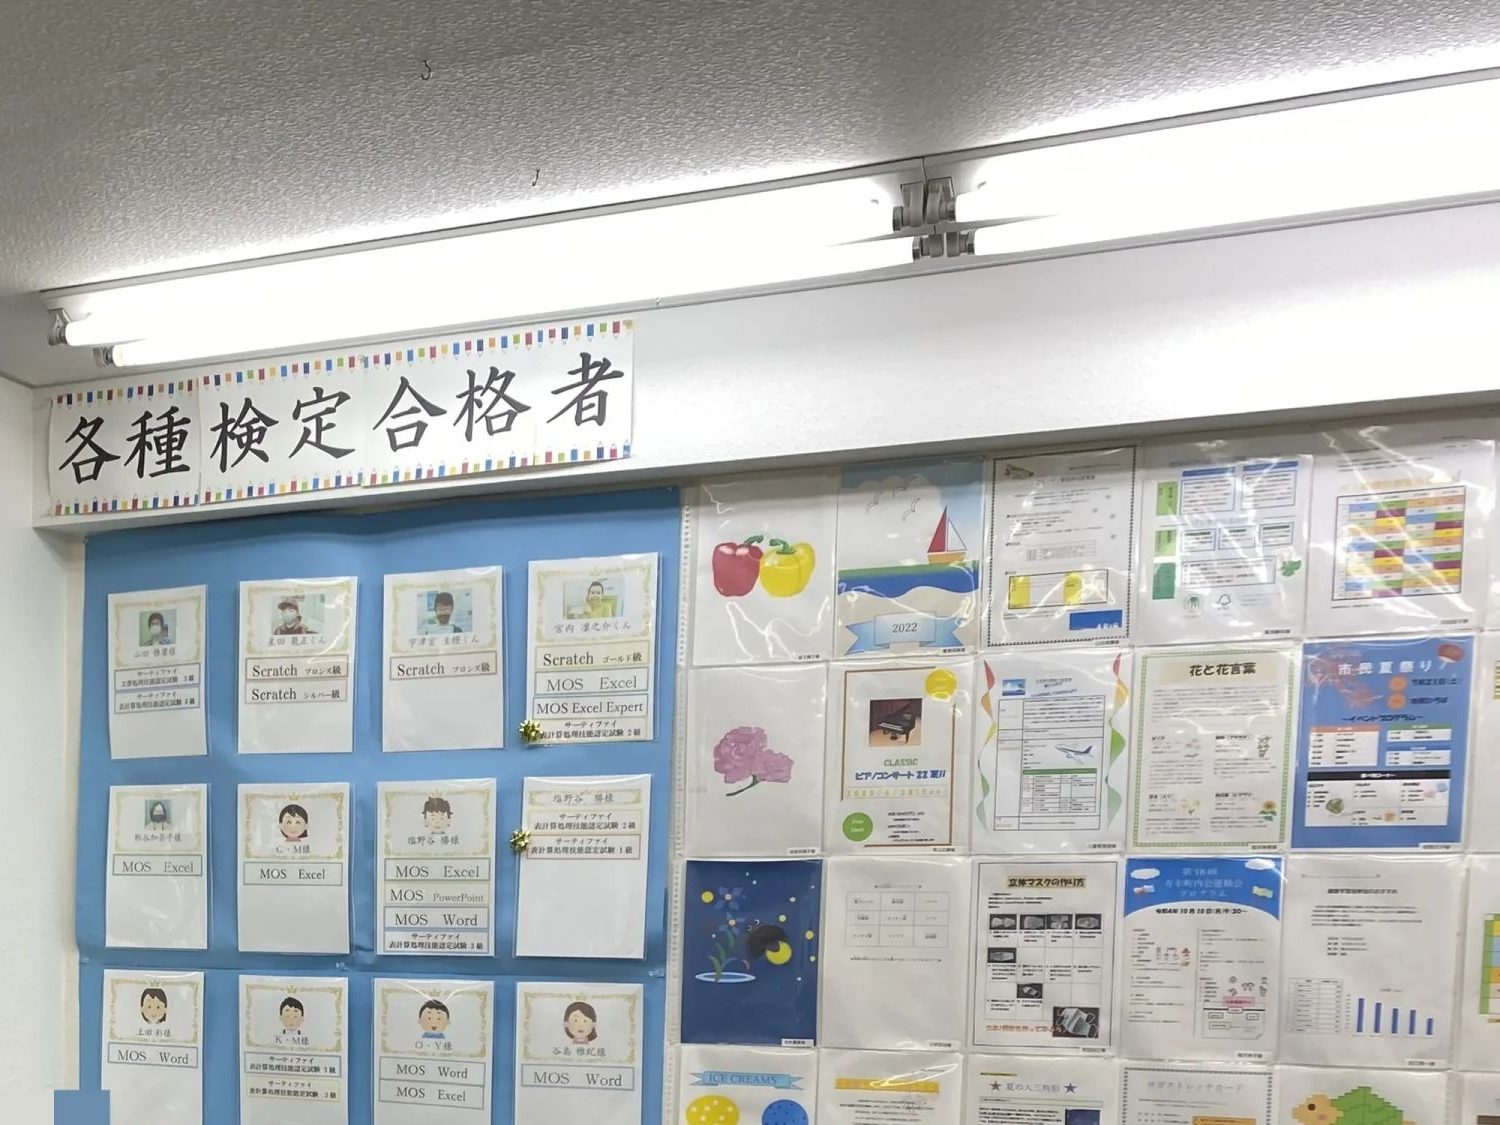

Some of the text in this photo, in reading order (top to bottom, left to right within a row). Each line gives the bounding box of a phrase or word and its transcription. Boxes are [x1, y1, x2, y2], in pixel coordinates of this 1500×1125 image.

[59, 352, 625, 486] 各種検定合格者
[892, 622, 918, 633] 2022
[543, 652, 642, 667] Scratch ゴールド級
[252, 664, 341, 677] Scratch ブロンズ級
[397, 662, 490, 677] Scratch ブロンズ級
[1190, 662, 1256, 677] 花と花言葉
[1338, 660, 1432, 676] 市民夏祭り
[547, 675, 637, 692] MOS Excel
[251, 688, 340, 701] Scratch シルバー級
[537, 701, 643, 715] MOS Excel Expert
[565, 720, 617, 729] サーティファイ
[883, 758, 918, 766] CLASSIC
[855, 771, 914, 780] ピアノコンサート
[534, 821, 619, 830] 表計算処理技能認定試験
[531, 846, 615, 854] 表計算処理技能認定試験
[122, 861, 194, 873] MOS Excel
[396, 865, 479, 878] MOS Excel
[260, 868, 325, 880] MOS Excel
[1008, 878, 1087, 887] 立体マスクの作り方
[390, 889, 484, 902] MOS PowerPoint
[395, 914, 478, 926] MOS Word
[389, 941, 467, 950] 表計算処理技能認定試験
[118, 1049, 189, 1064] MOS Word
[269, 1056, 314, 1064] サーティファイ
[396, 1064, 468, 1079] MOS Word
[533, 1071, 622, 1087] MOS Word
[709, 1073, 778, 1085] ICE CREAMS
[396, 1087, 466, 1102] MOS Excel
